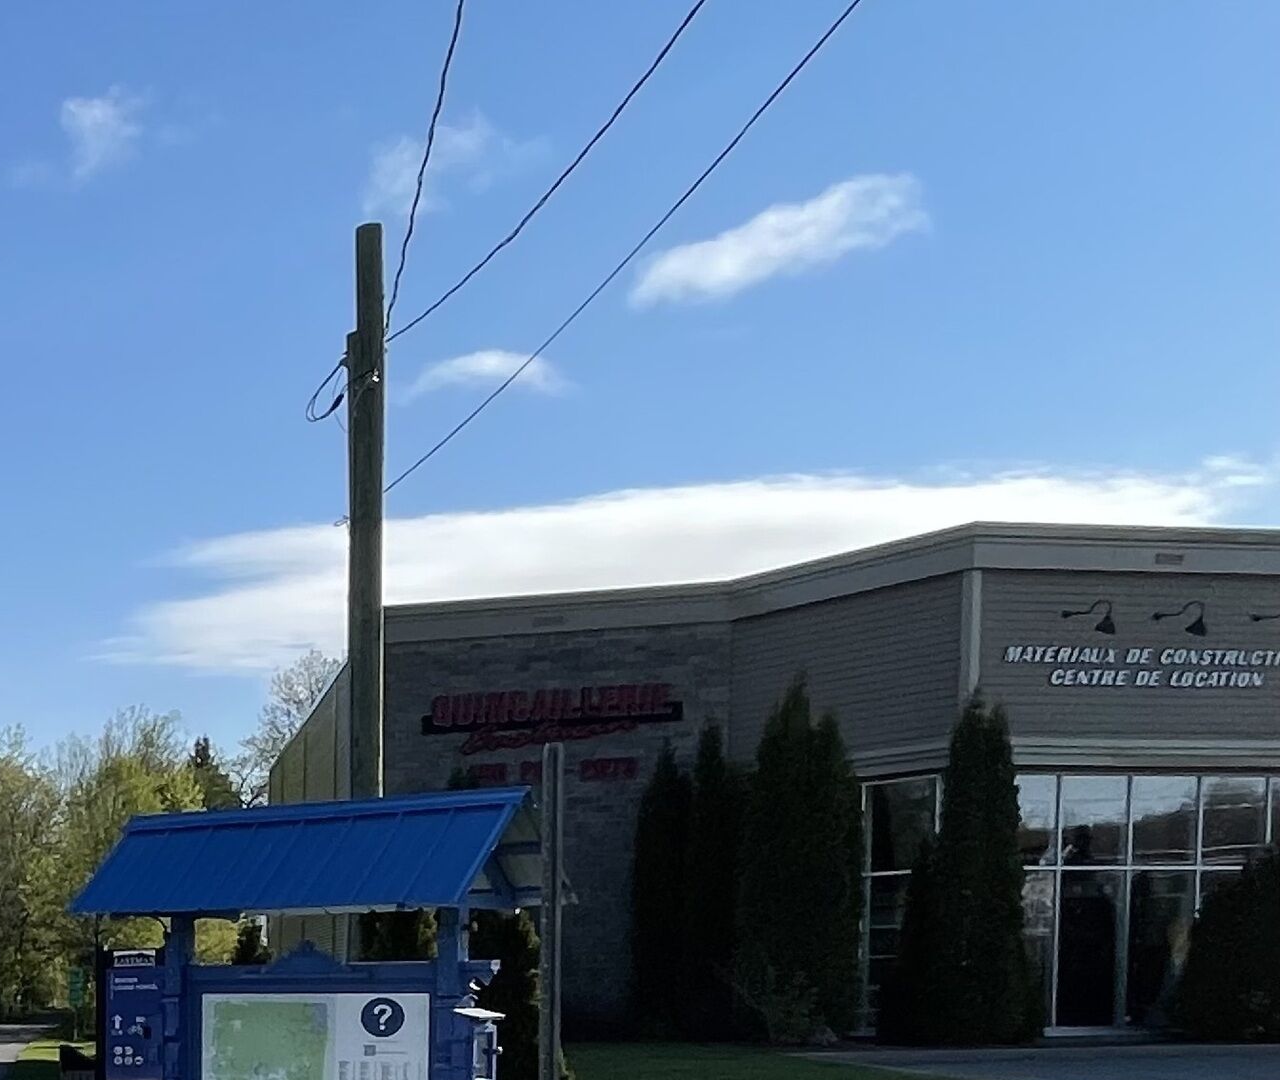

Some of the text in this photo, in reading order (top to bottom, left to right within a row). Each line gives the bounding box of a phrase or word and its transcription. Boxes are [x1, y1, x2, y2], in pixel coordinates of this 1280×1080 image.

[1126, 649, 1153, 664] DE
[1051, 669, 1264, 687] CENTRE DE LOCATION
[432, 683, 673, 727] QUINCAILLERIE
